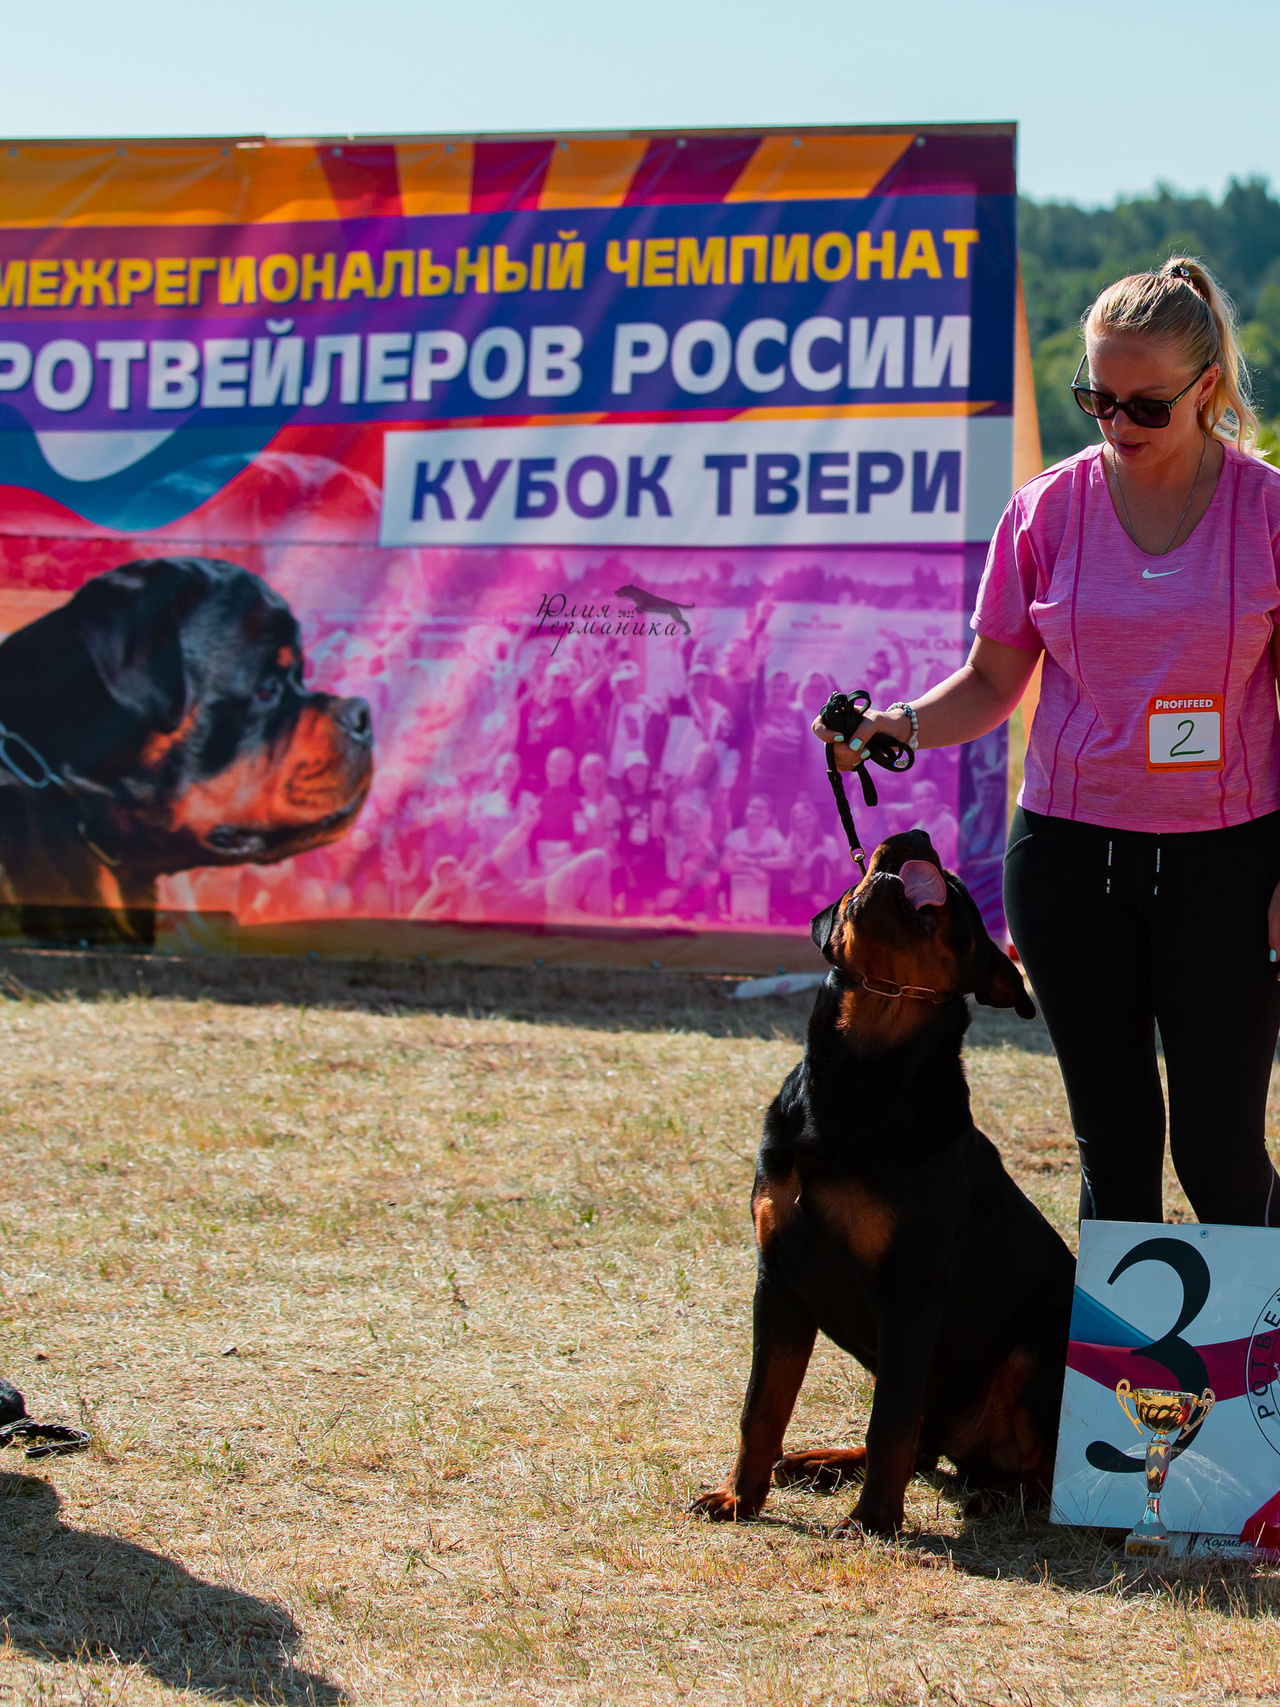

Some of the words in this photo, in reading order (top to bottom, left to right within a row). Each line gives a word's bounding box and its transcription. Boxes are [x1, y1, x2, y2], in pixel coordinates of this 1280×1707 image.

[605, 229, 980, 287] ЧЕМПИОНАТ
[0, 319, 583, 412] РОТВЕЙЛЕРОВ
[612, 315, 971, 395] РОССИИ
[411, 454, 673, 522] КУБОК
[704, 450, 961, 517] ТВЕРИ
[1155, 699, 1214, 710] PROFIFEED
[1169, 719, 1205, 757] 2
[1085, 1237, 1211, 1474] 3
[1202, 1536, 1241, 1549] Корма
